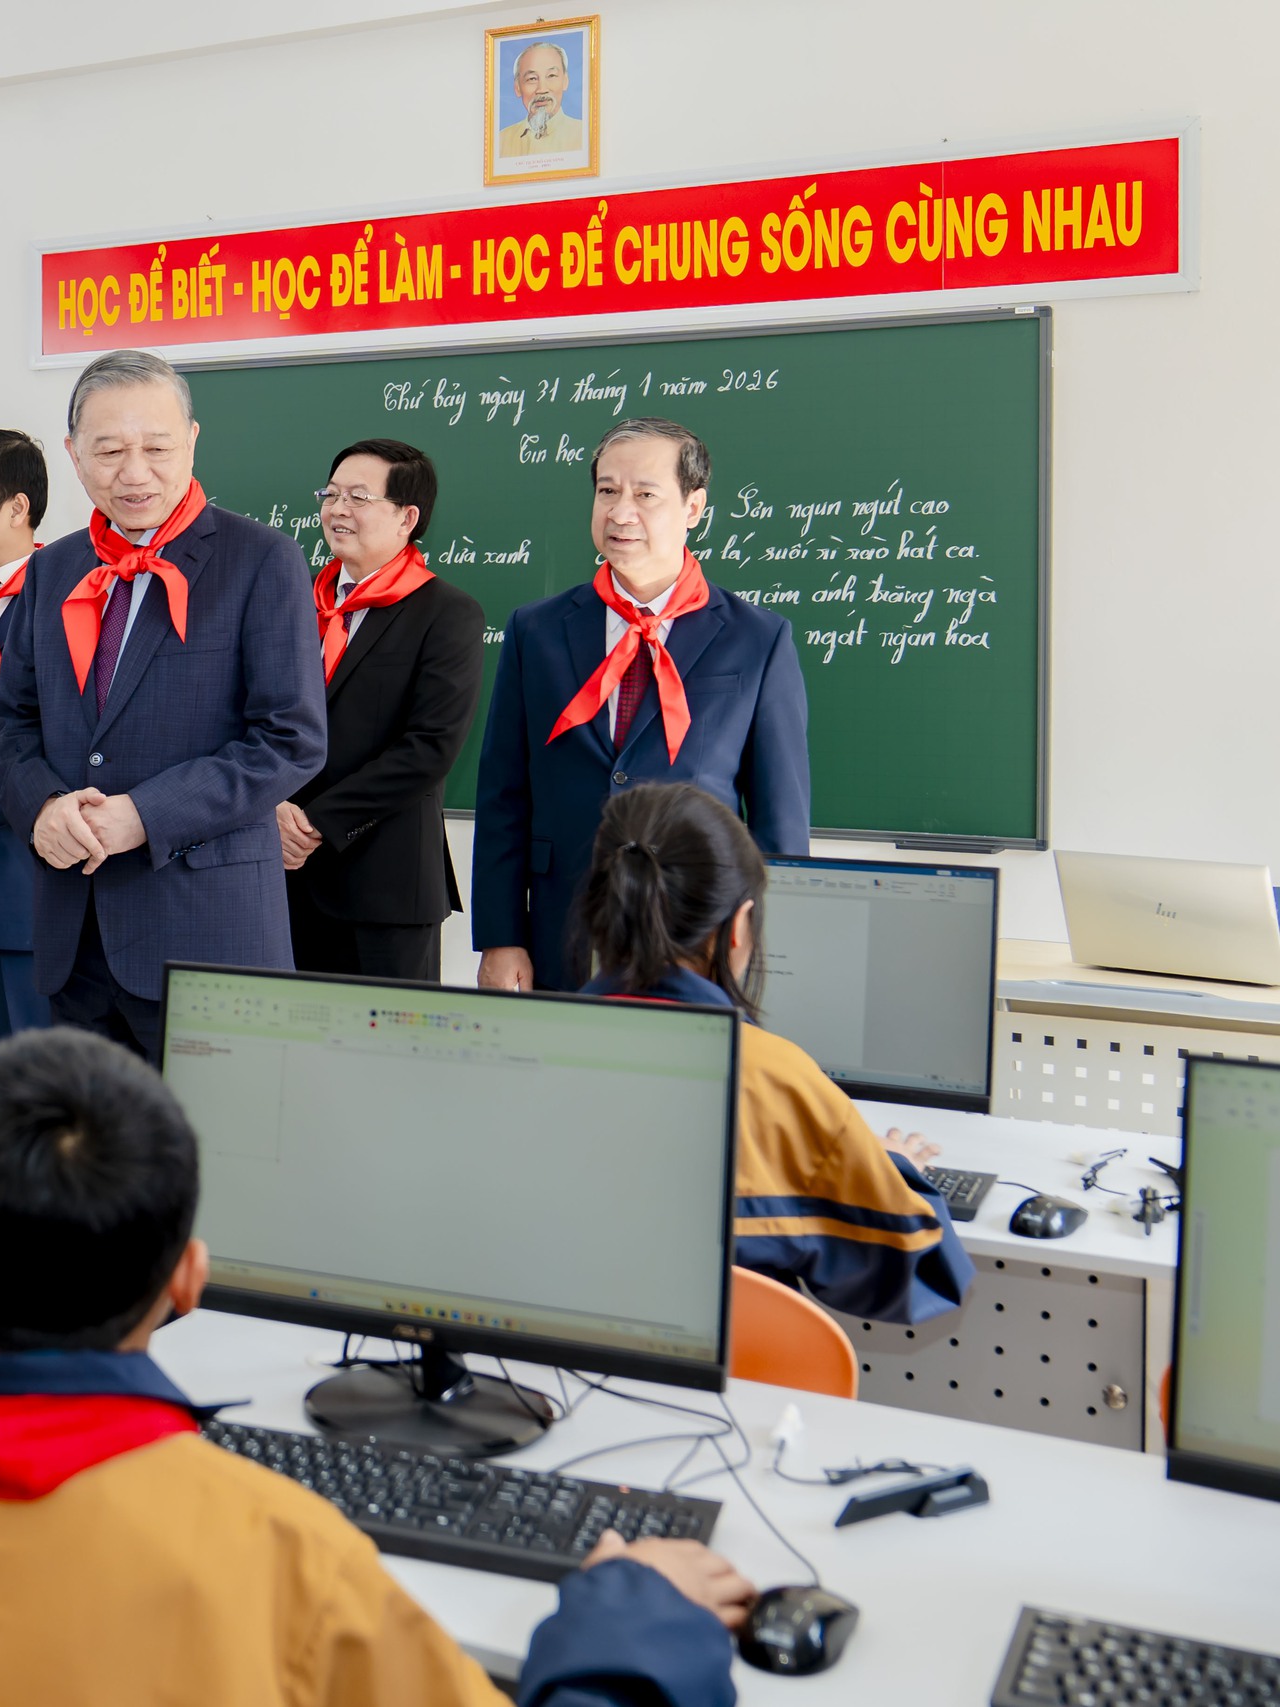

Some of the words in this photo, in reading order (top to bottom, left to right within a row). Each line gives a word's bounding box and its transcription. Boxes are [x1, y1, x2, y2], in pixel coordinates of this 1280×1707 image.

[58, 275, 121, 336] HỌC
[129, 244, 167, 323] ĐỂ
[173, 243, 227, 320] BIẾT
[251, 255, 321, 320] HỌC
[330, 223, 373, 307] ĐỂ
[379, 233, 443, 303] LÀM
[473, 234, 550, 303] HỌC
[560, 199, 608, 288] ĐỂ
[614, 216, 750, 285] CHUNG
[761, 182, 873, 273] SỐNG
[886, 182, 1008, 264] CÙNG
[1023, 181, 1143, 253] NHAU
[383, 378, 431, 411] Thứ
[432, 377, 467, 426] bảy
[478, 375, 526, 427] ngày
[536, 376, 560, 403] 31
[569, 368, 628, 417] tháng
[638, 371, 652, 397] 1
[659, 376, 708, 396] năm
[716, 368, 780, 393] 2026
[555, 433, 585, 467] học
[909, 500, 950, 516] cao
[482, 538, 532, 565] xanh
[757, 537, 816, 561] suối
[896, 524, 939, 560] hát
[811, 571, 857, 603] ánh
[942, 575, 997, 625] ngà
[804, 609, 869, 665] ngát
[944, 617, 991, 650] hoa
